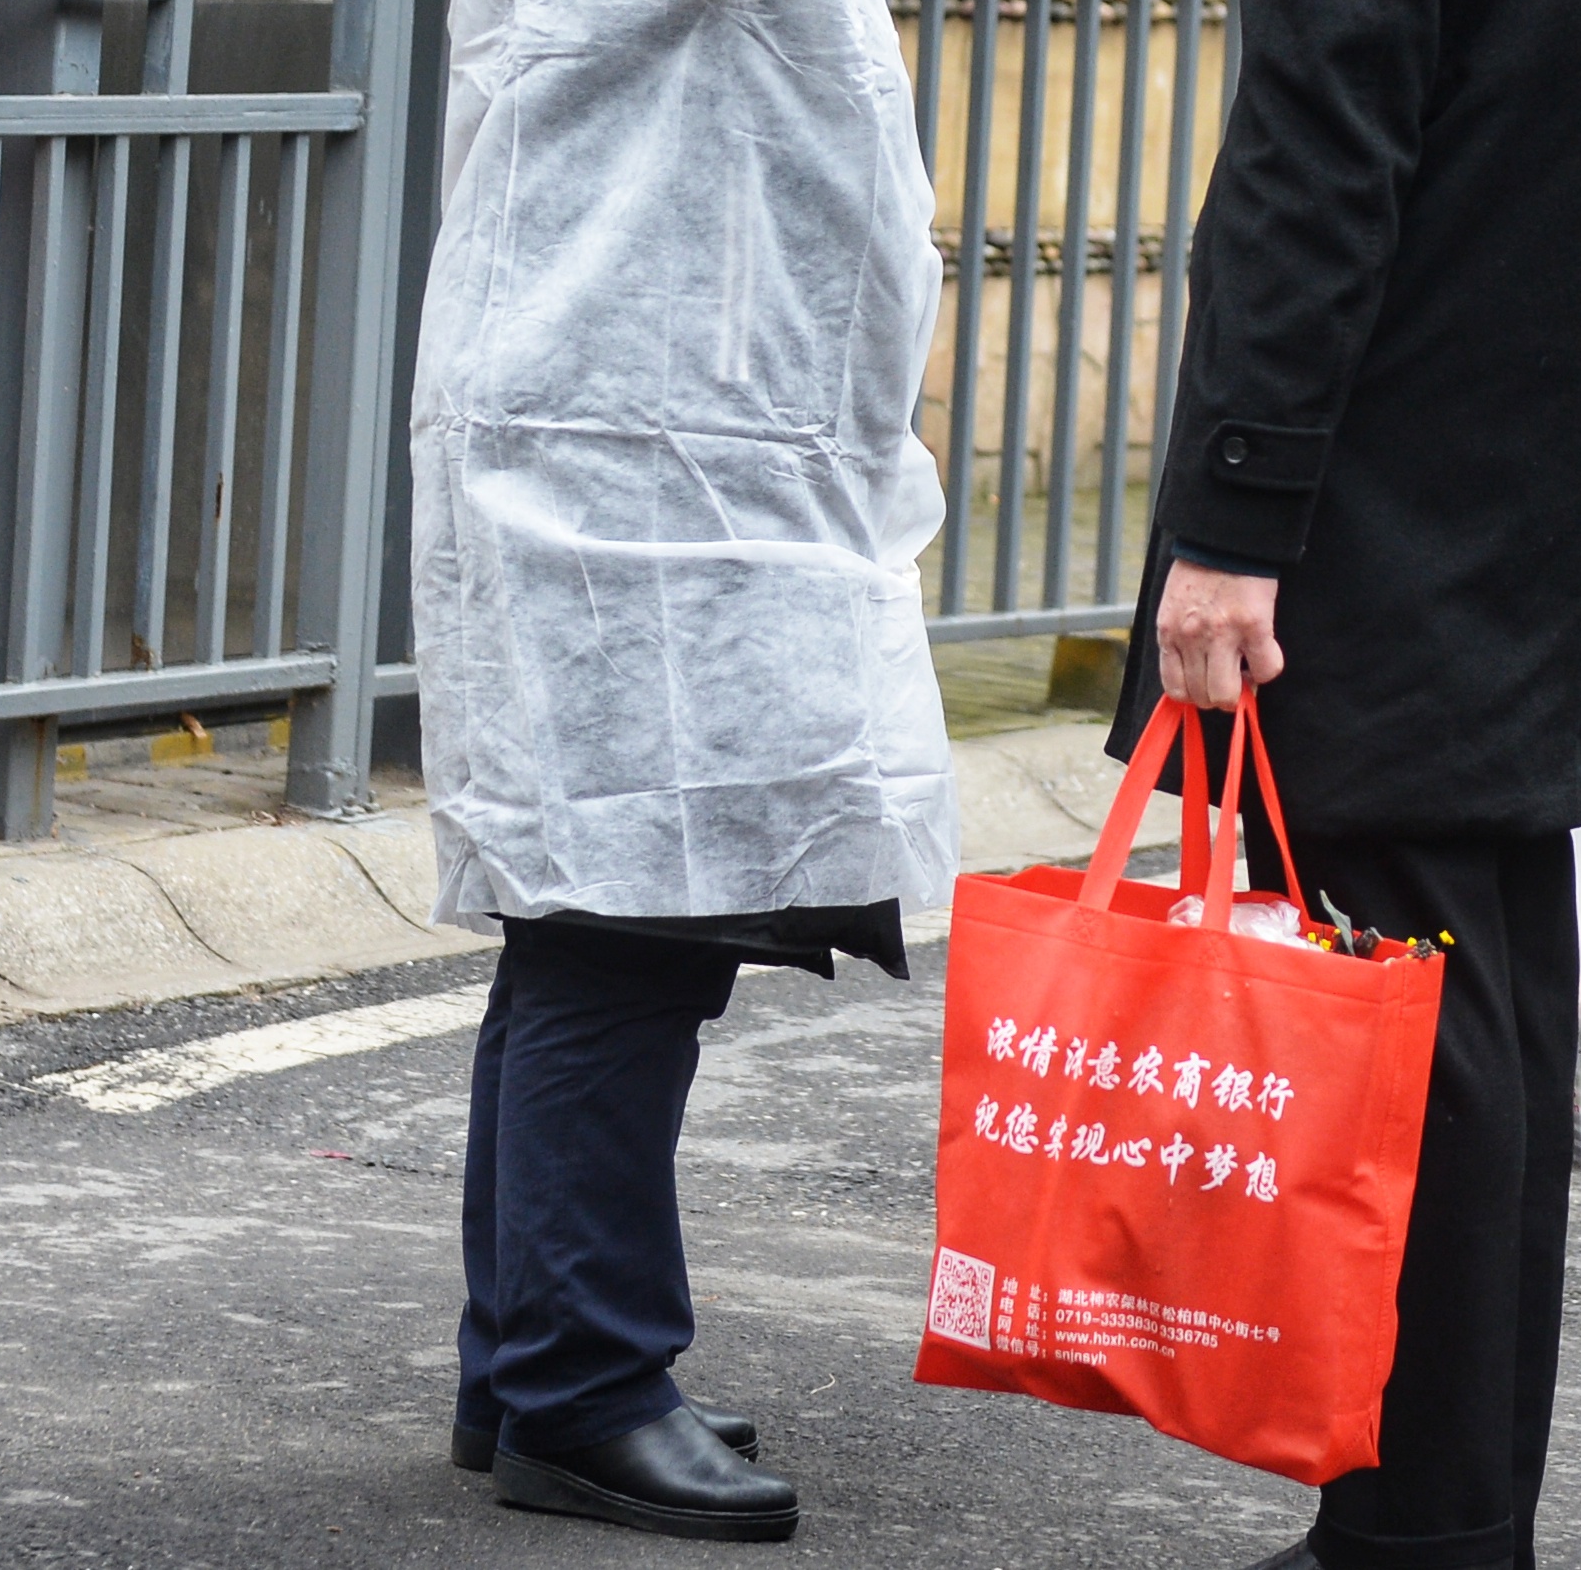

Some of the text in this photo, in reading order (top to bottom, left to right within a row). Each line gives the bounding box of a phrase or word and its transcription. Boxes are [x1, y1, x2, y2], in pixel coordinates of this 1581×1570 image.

[974, 1093, 1279, 1202] 祝您实现心中梦想
